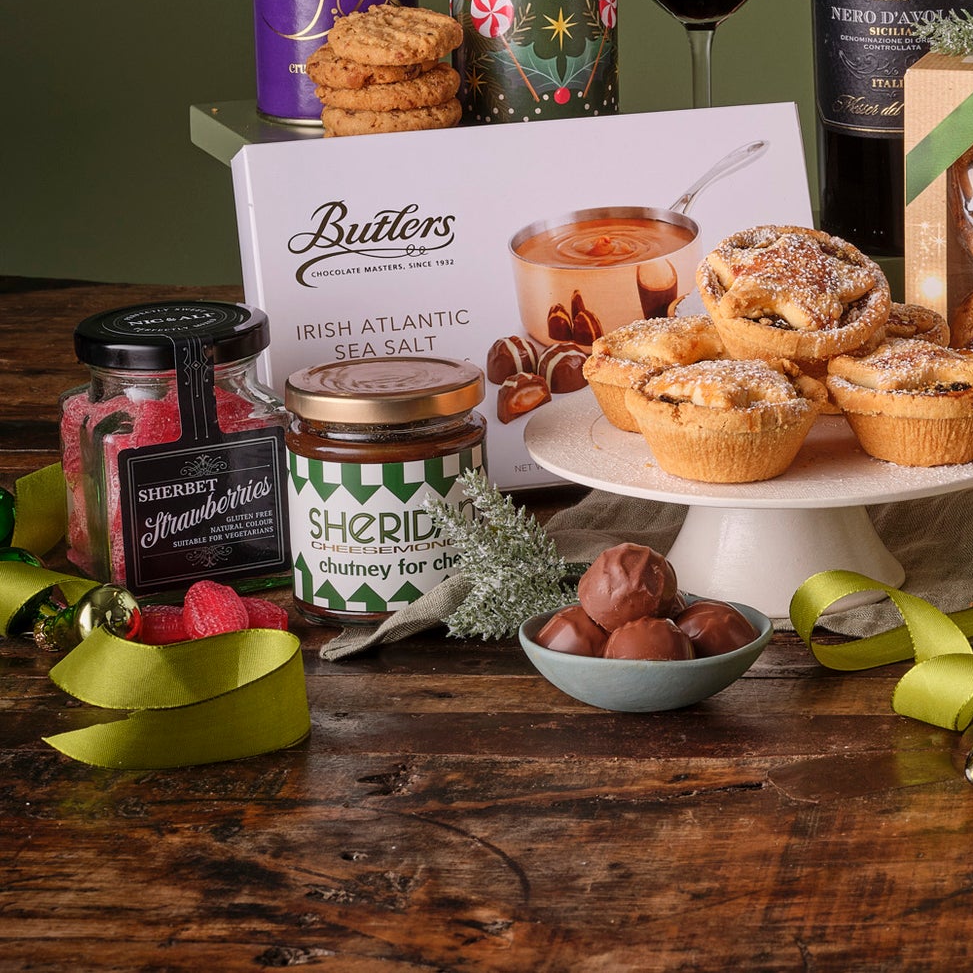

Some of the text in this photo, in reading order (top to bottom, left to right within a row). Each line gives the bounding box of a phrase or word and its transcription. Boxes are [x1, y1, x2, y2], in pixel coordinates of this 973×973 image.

[831, 6, 950, 25] NERO D'AVOL
[840, 34, 903, 44] DENOMINAZIONE
[869, 26, 913, 36] SICILIA
[871, 78, 904, 88] ITALI
[288, 200, 456, 258] Butlers
[311, 258, 455, 278] CHOCOLATE MASTERS, SINCE 1932
[296, 309, 470, 341] IRISH ATLANTIC
[335, 335, 437, 360] SEA SALT
[514, 463, 533, 473] NET
[138, 478, 218, 503] SHERBET
[140, 476, 272, 549] Strawberries
[226, 510, 273, 523] GLUTEN FREE
[210, 518, 273, 534] NATURAL COLOUR
[173, 527, 274, 548] SUITABLE FOR VEGETARIANS
[319, 557, 391, 580] chutney
[398, 558, 427, 576] for
